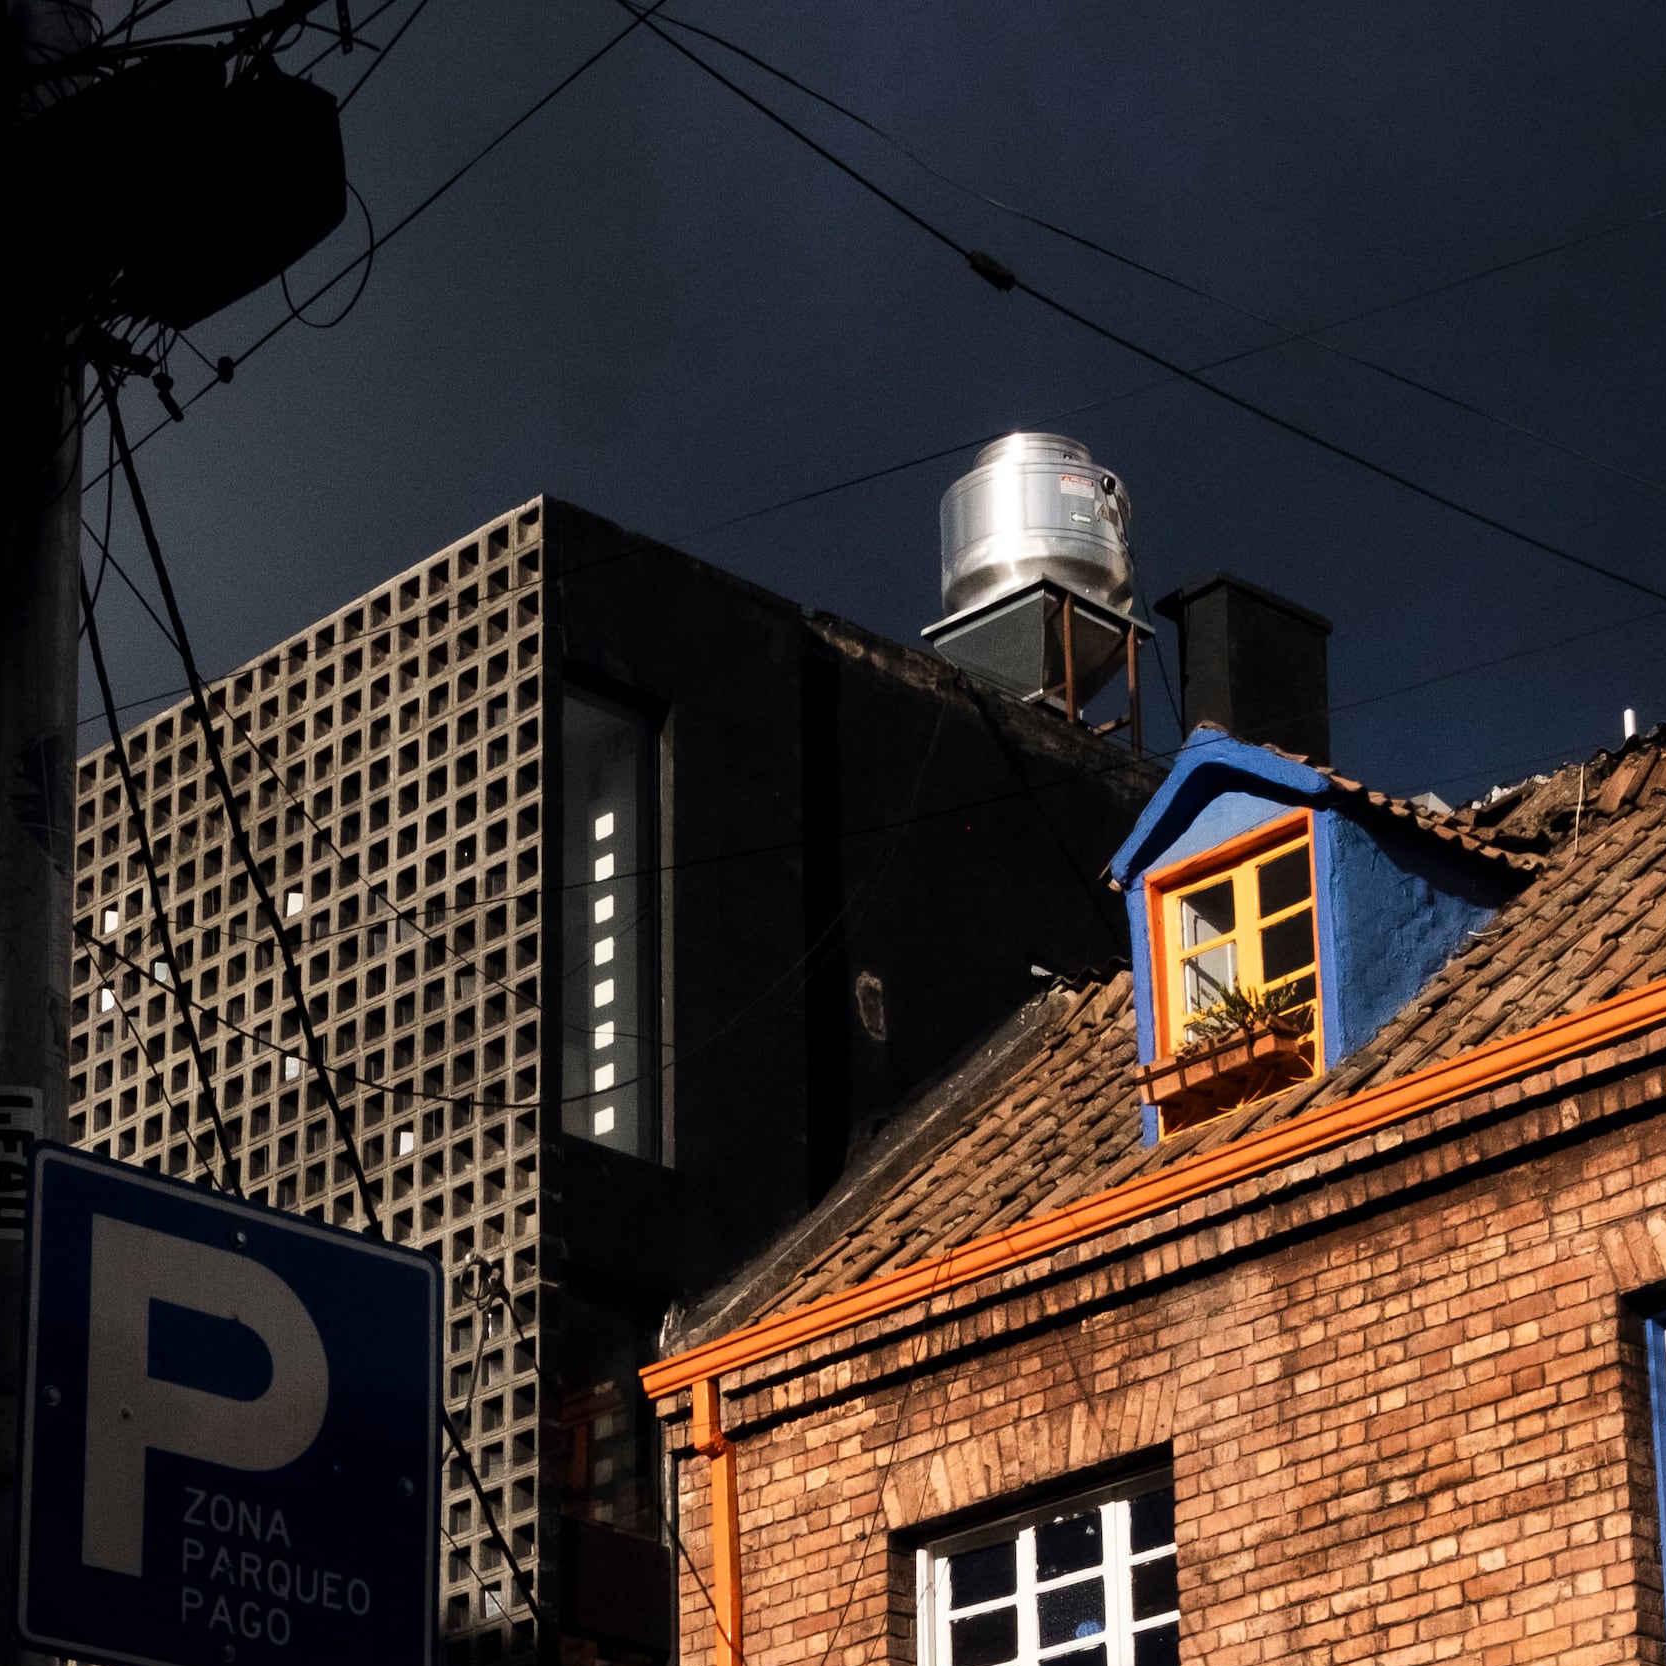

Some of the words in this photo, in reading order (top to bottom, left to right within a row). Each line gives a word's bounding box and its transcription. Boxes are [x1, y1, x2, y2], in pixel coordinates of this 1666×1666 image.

[81, 1212, 330, 1579] P
[183, 1486, 291, 1550] ZONA
[181, 1537, 371, 1616] PARQUEO
[181, 1586, 291, 1646] PAGO
